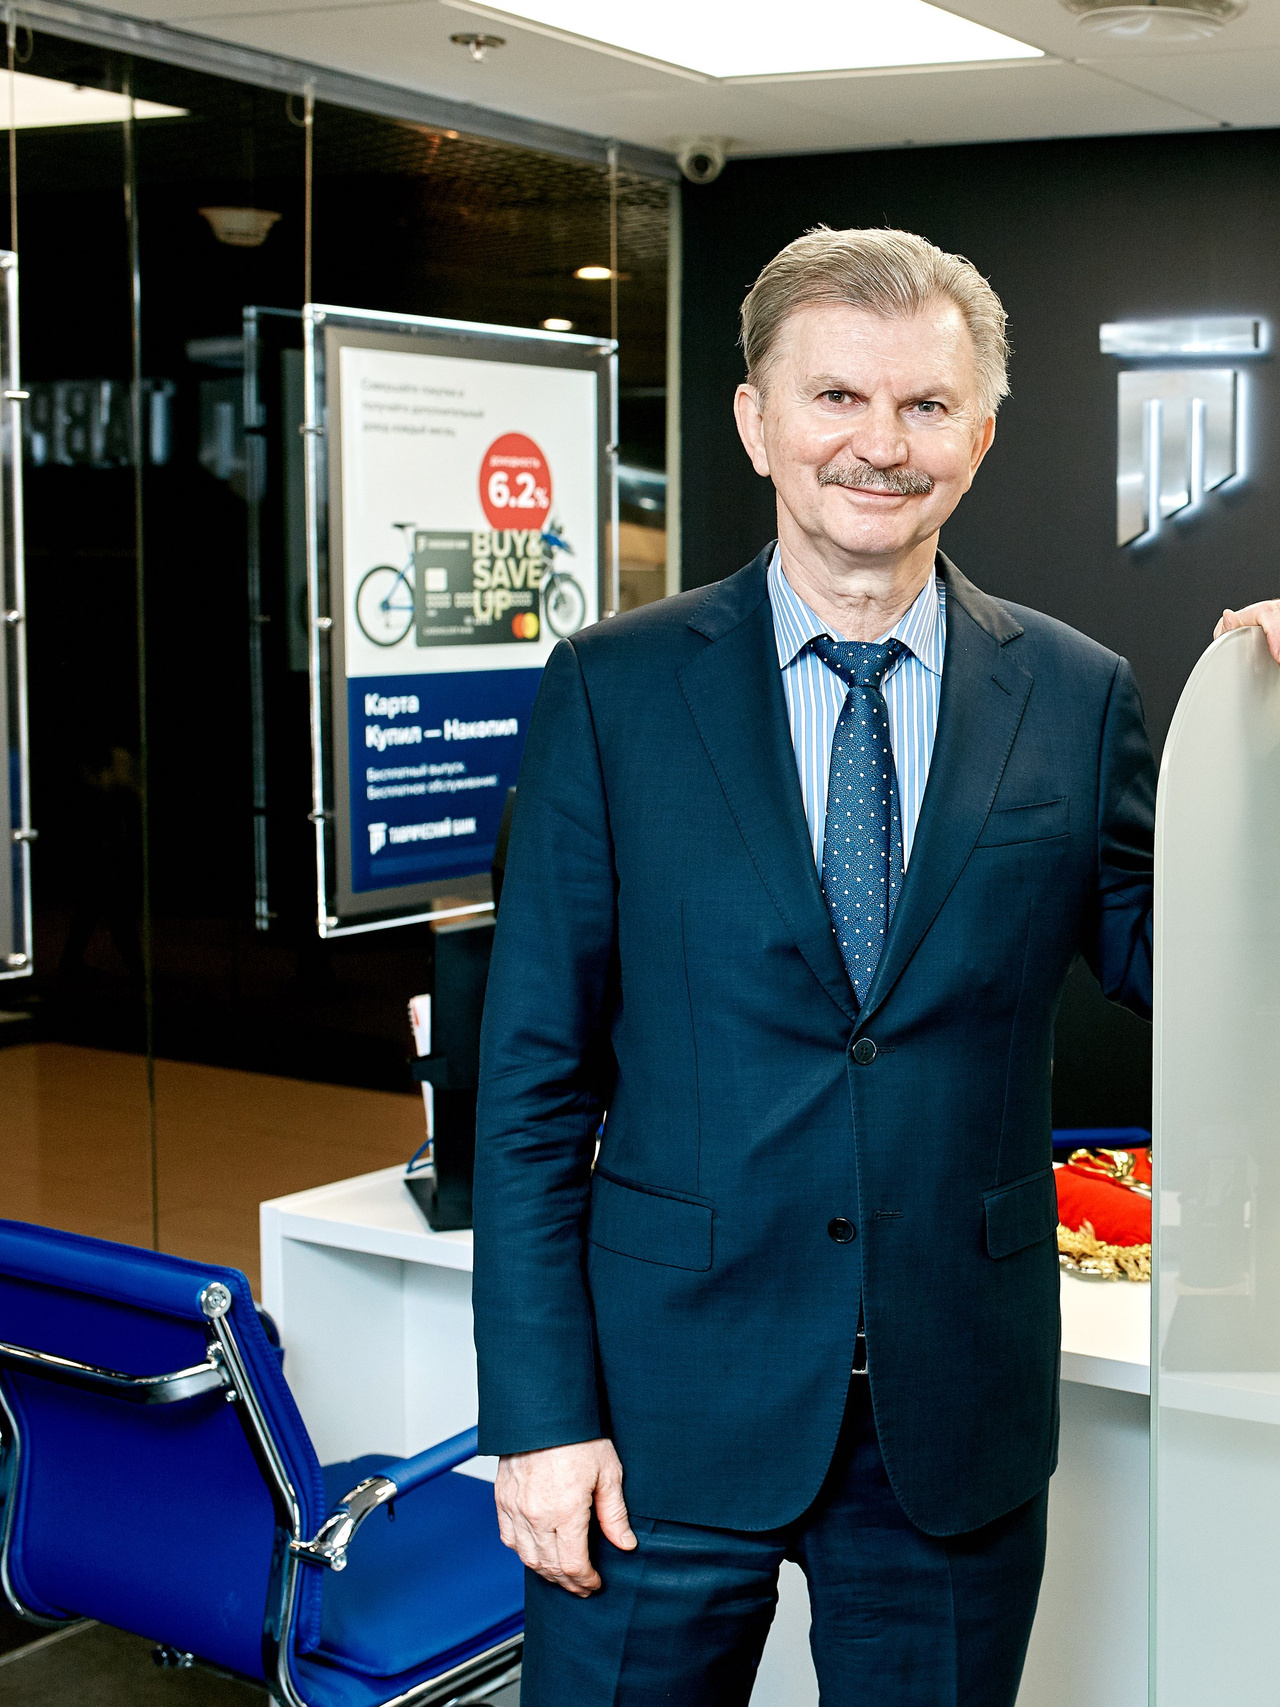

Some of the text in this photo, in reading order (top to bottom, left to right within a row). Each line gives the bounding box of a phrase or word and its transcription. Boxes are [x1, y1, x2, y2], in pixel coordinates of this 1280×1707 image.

[488, 470, 550, 509] 6.2%
[472, 557, 542, 590] SAVE
[472, 589, 512, 621] UP
[365, 693, 419, 719] Карта
[365, 724, 421, 751] Купил
[444, 718, 517, 741] Накопил
